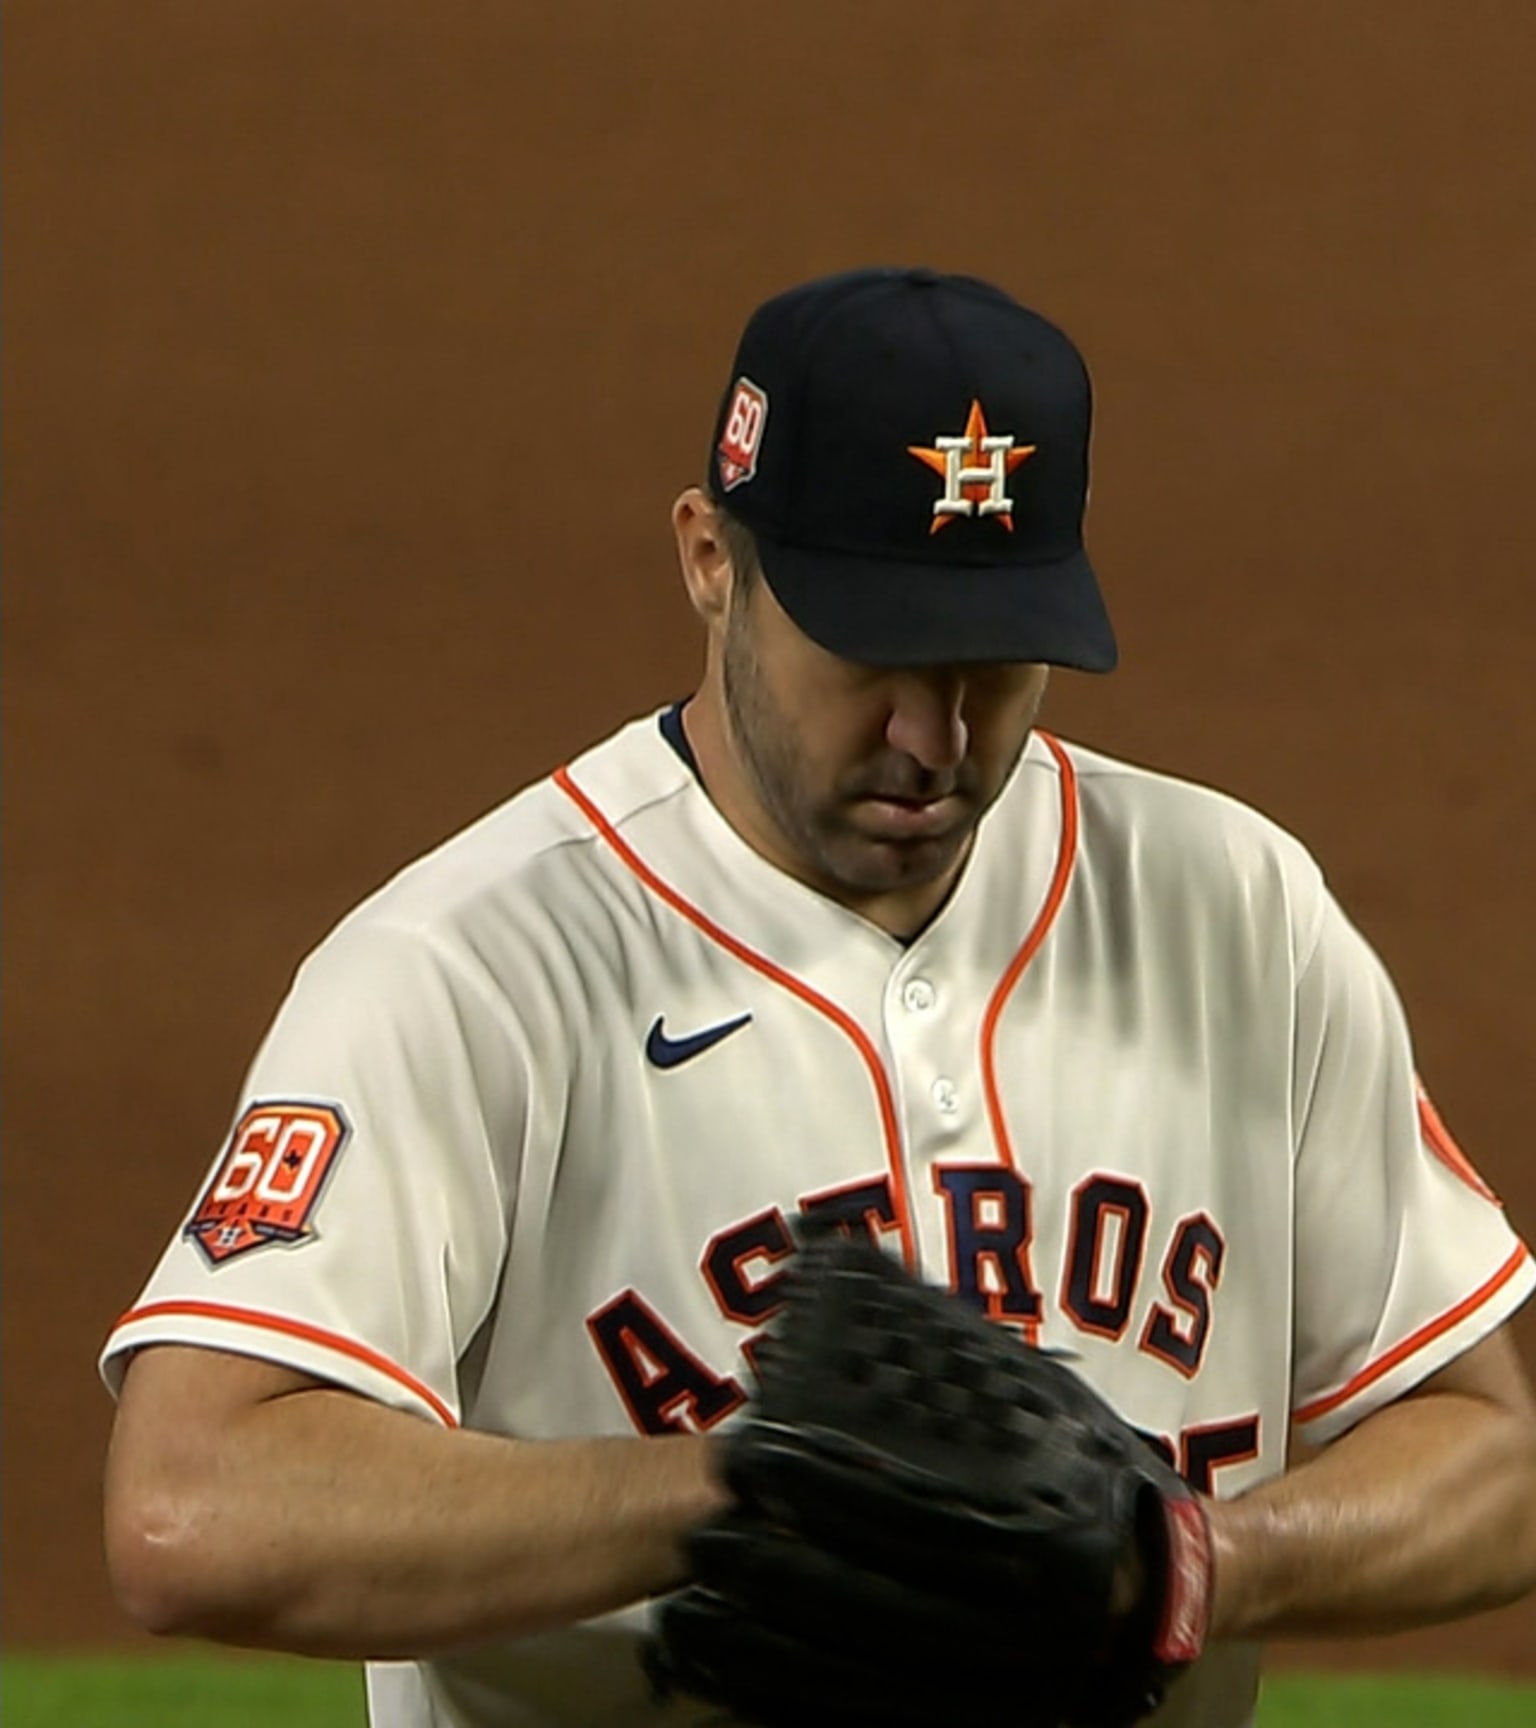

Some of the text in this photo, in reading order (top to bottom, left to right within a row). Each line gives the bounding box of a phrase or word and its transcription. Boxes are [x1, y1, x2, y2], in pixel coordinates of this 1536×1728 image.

[727, 392, 761, 454] 60
[933, 435, 1014, 517] H
[212, 1116, 327, 1204] 60
